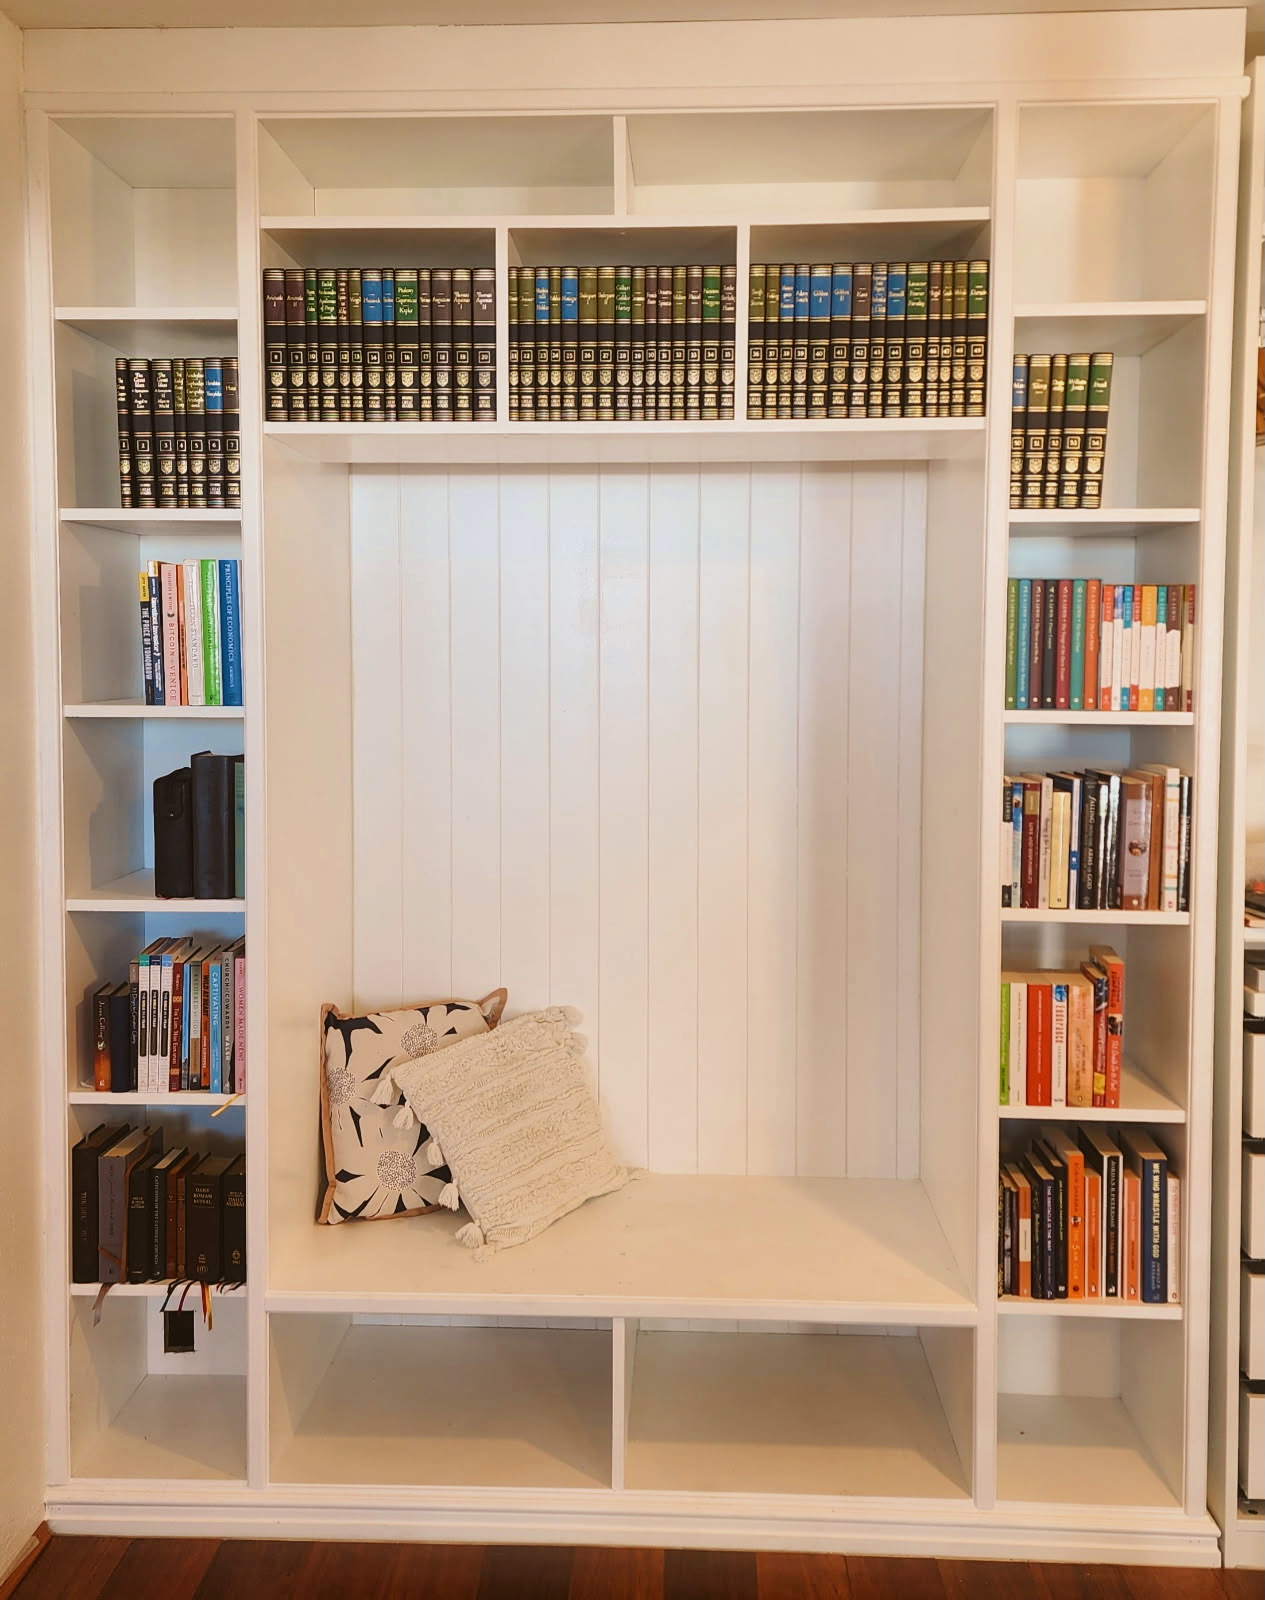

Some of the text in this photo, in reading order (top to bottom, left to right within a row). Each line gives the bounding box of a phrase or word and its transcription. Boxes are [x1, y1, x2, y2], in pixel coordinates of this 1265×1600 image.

[224, 563, 233, 605] PRINCIPLES
[226, 605, 233, 616] OF
[227, 616, 235, 662] ECONOMICS
[144, 646, 153, 680] TOMORROW
[170, 665, 178, 701] VENICE
[212, 971, 220, 1026] CAPTIVATING
[1152, 1163, 1160, 1258] WE WHO WRESTLE WITH GOD
